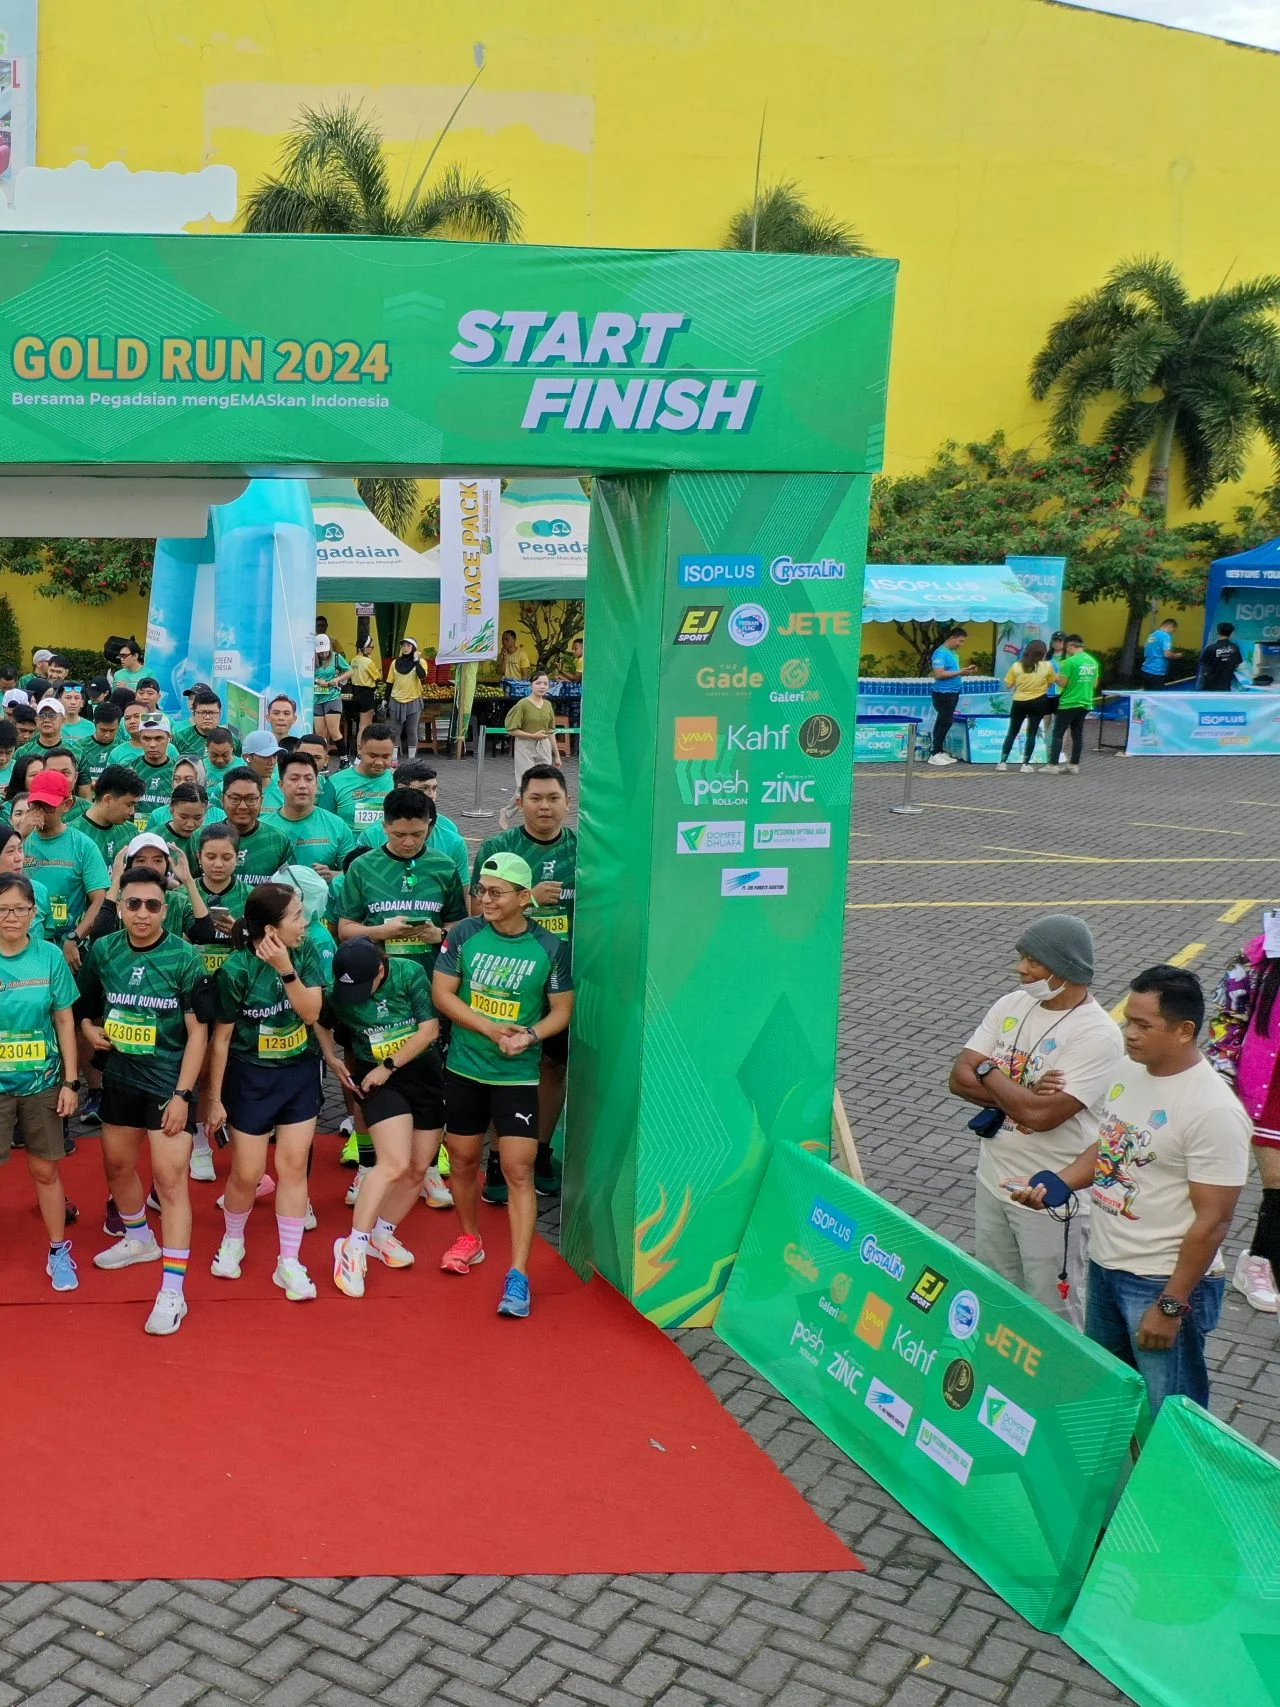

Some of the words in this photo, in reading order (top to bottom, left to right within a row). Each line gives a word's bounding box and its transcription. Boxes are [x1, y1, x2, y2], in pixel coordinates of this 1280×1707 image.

[450, 310, 684, 364] START
[14, 336, 147, 380] GOLD
[161, 338, 263, 381] RUN
[274, 340, 391, 382] 2024
[12, 391, 85, 406] Bersama
[90, 392, 177, 409] Pegadaian
[182, 393, 306, 410] mengEMASkan
[311, 393, 390, 408] Indonesia
[521, 378, 756, 431] FINISH
[459, 481, 481, 547] PACK
[317, 546, 400, 562] gadaian
[463, 551, 482, 615] RACE
[684, 565, 755, 582] ISOPLUS
[1017, 575, 1056, 586] SOPLUS
[1263, 570, 1280, 579] YOU
[681, 611, 718, 634] EJ
[777, 612, 851, 636] JETE
[677, 634, 709, 642] SPORT
[696, 667, 764, 688] Gade
[727, 724, 790, 751] Kahf
[694, 769, 749, 806] posh
[761, 780, 816, 803] ZINC
[712, 797, 748, 806] ROLL-ON
[138, 994, 179, 1009] RUNNERS
[474, 994, 515, 1018] 123002
[108, 1023, 151, 1042] 123066
[264, 1028, 305, 1049] 123011
[811, 1205, 852, 1243] ISOPLUS
[915, 1271, 945, 1303] EJ
[909, 1292, 932, 1310] SPORT
[789, 1320, 825, 1355] posh
[891, 1323, 938, 1376] Kahf
[985, 1323, 1042, 1377] JETE
[826, 1351, 863, 1395] ZINC
